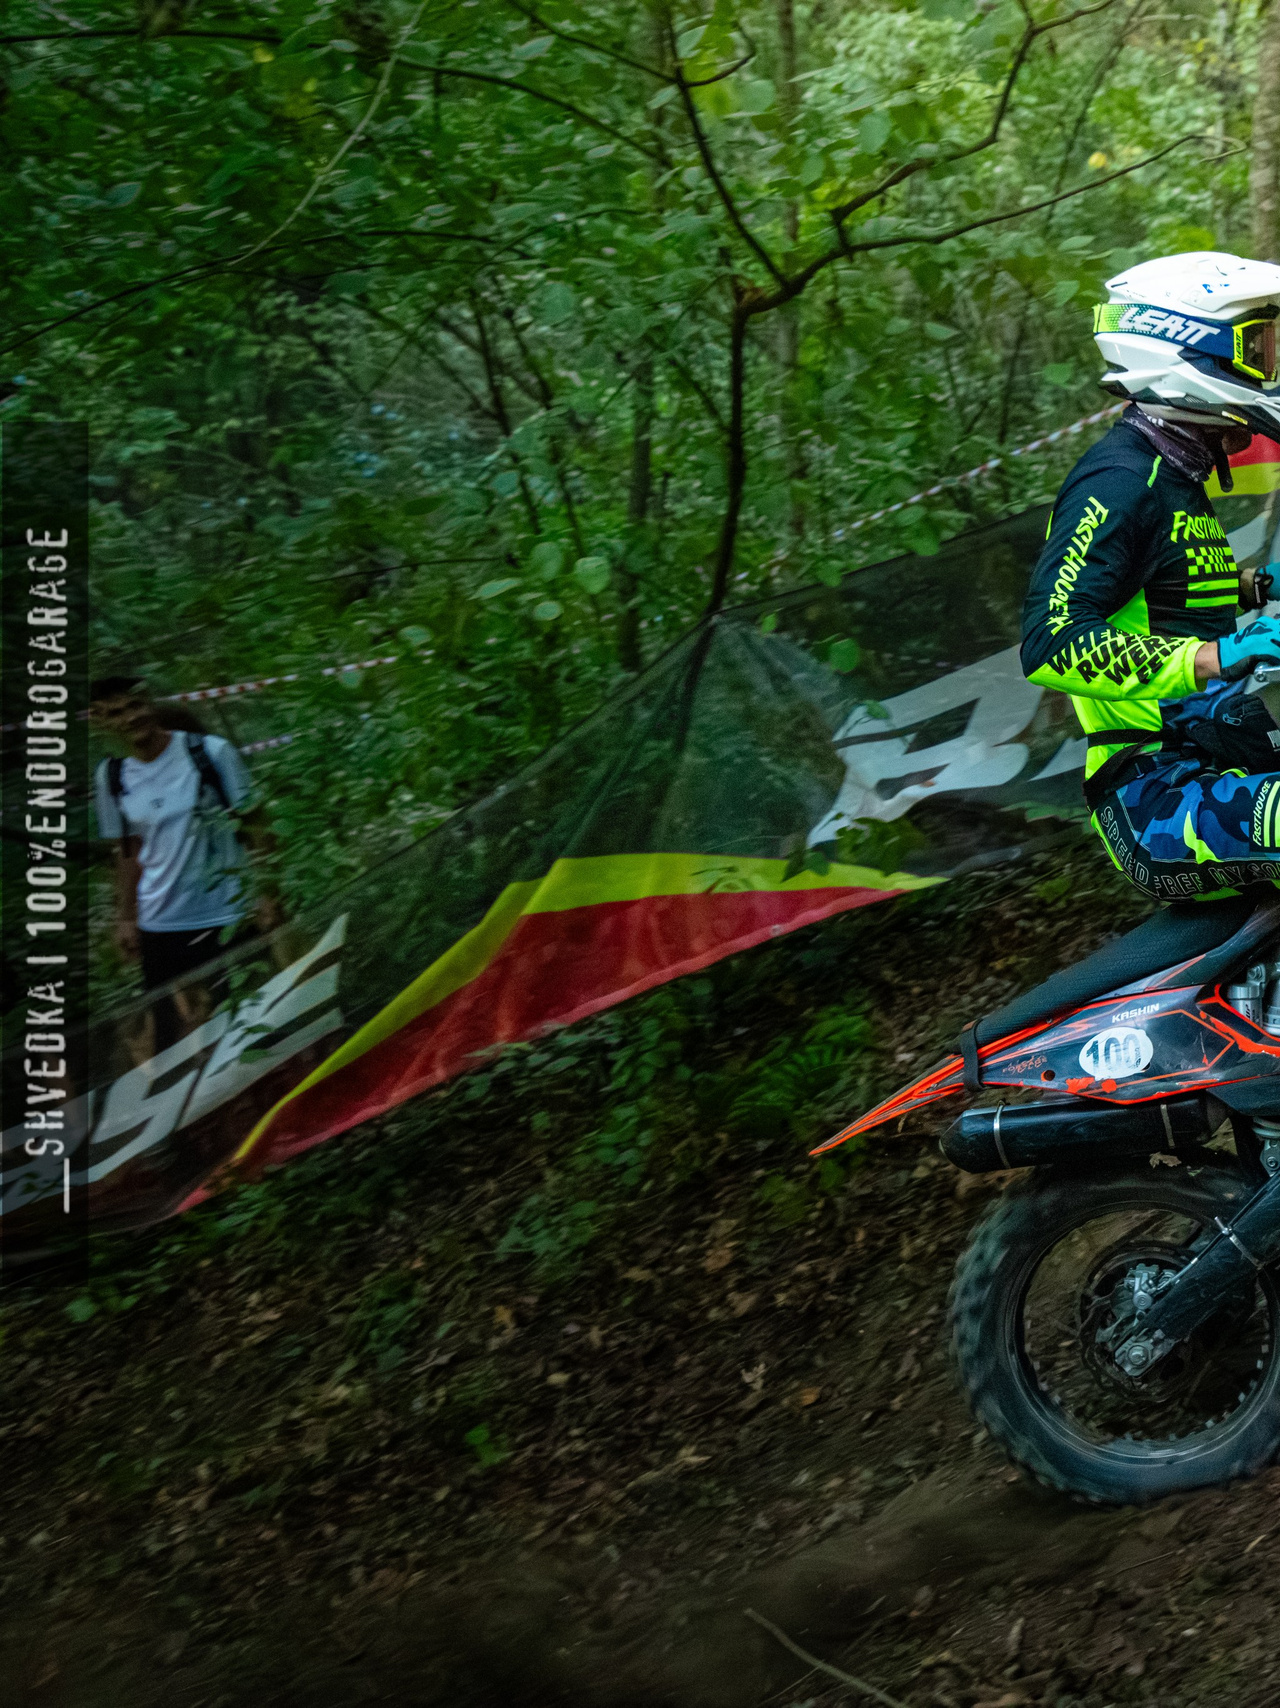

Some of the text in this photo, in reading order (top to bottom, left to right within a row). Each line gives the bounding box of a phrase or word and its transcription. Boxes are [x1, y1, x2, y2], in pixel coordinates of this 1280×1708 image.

[1118, 307, 1221, 346] LEATT
[1252, 780, 1272, 847] FASTHOUSE
[1101, 806, 1149, 885] SPEED
[1111, 1003, 1161, 1024] KASHIN
[1085, 1032, 1142, 1074] 100
